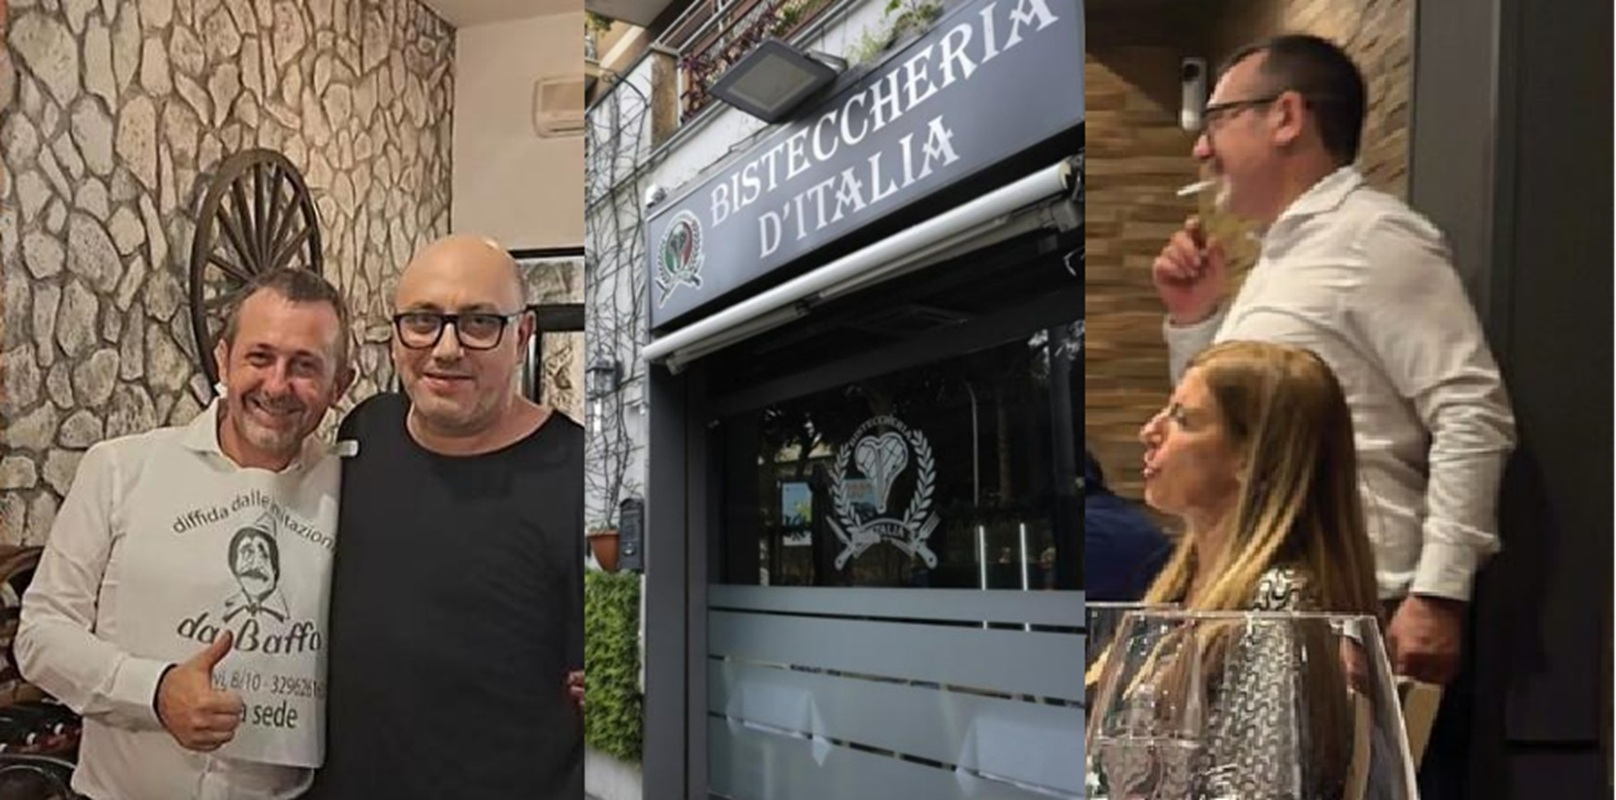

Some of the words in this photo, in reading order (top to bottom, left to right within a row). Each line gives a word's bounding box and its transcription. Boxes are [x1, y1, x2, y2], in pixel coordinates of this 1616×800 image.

[710, 0, 1059, 228] BISTECCHERIA
[758, 115, 960, 259] D'ITALIA
[172, 506, 230, 534] diffida
[232, 489, 271, 512] dalle
[177, 612, 220, 644] da
[234, 618, 322, 655] Baffo
[252, 700, 298, 730] sede
